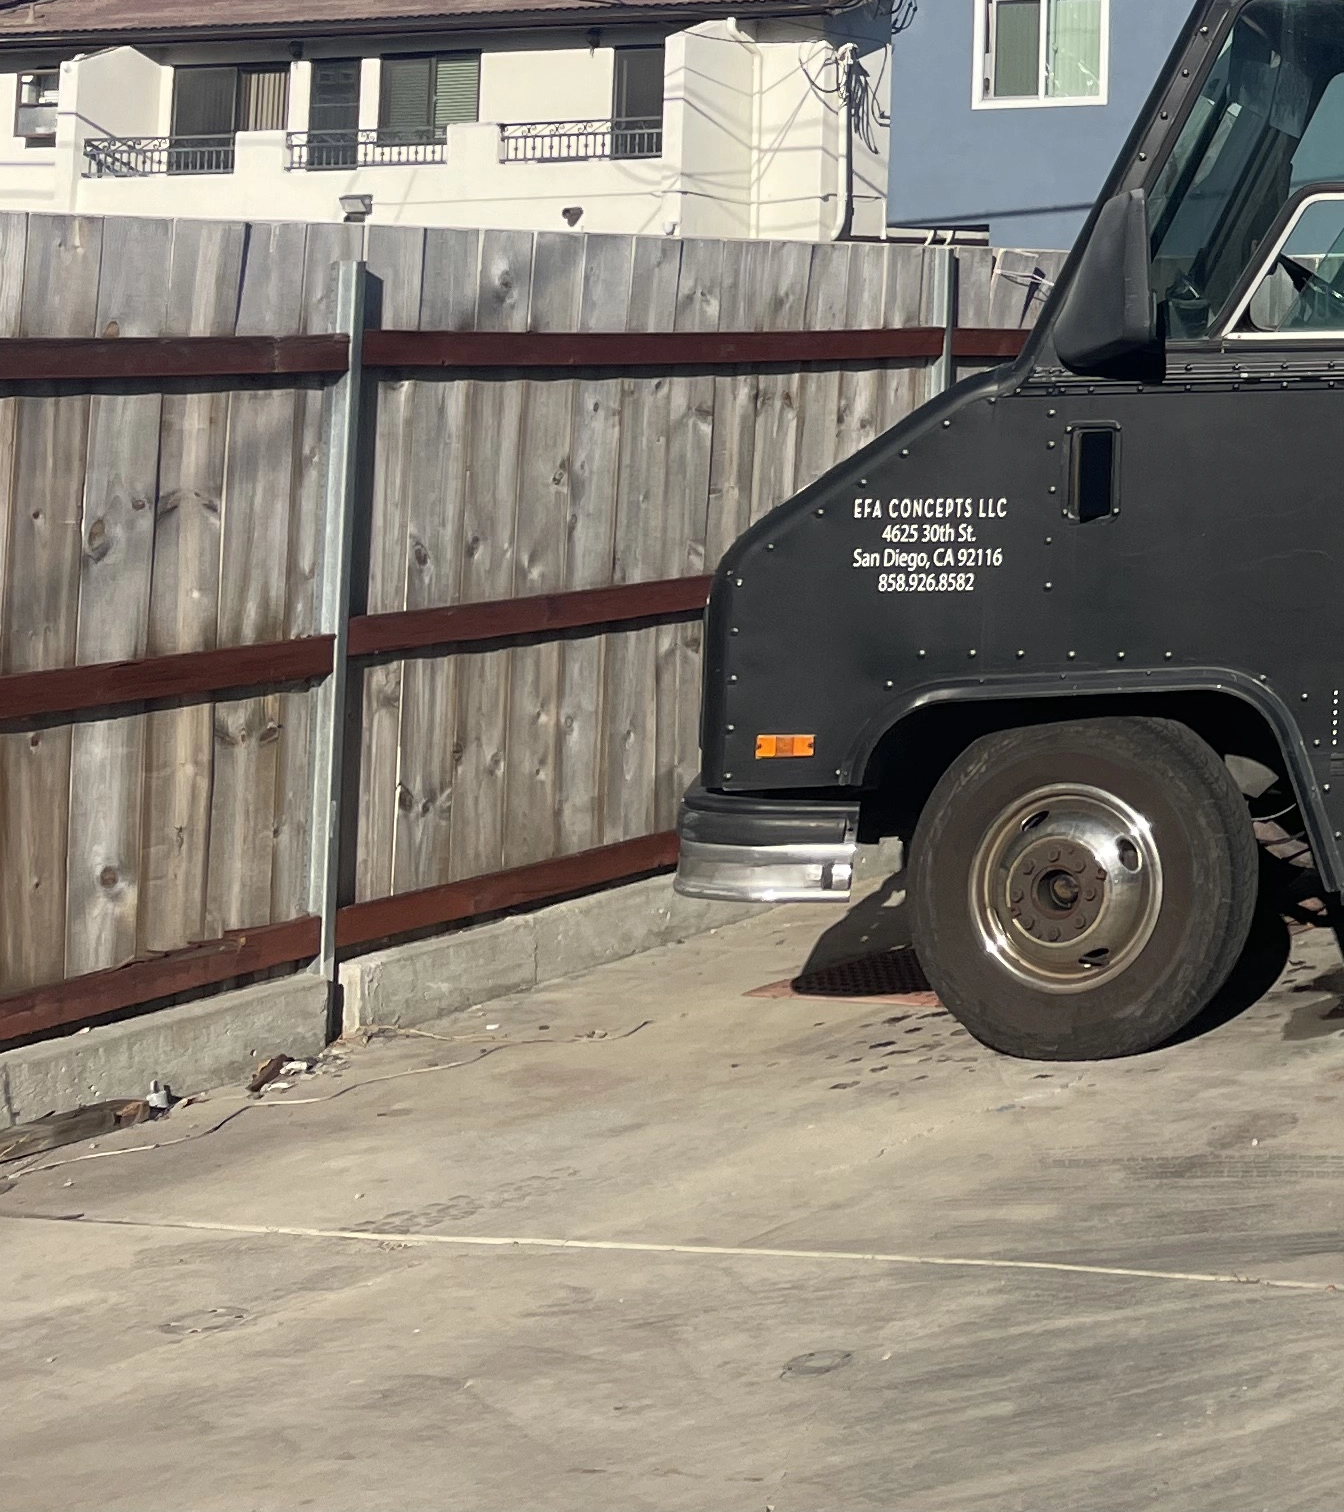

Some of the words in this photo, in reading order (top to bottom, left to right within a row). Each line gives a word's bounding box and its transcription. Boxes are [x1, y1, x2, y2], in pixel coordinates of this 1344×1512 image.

[854, 498, 882, 519] EFA
[888, 497, 972, 519] CONCEPTS
[978, 497, 1008, 518] LLC
[882, 524, 918, 543] 4625
[921, 524, 954, 543] 30th
[957, 523, 977, 543] St.
[853, 549, 880, 568] San
[883, 548, 930, 572] Diego,
[932, 549, 953, 567] CA
[957, 548, 1003, 567] 92116
[878, 573, 975, 592] 858.926.8582
